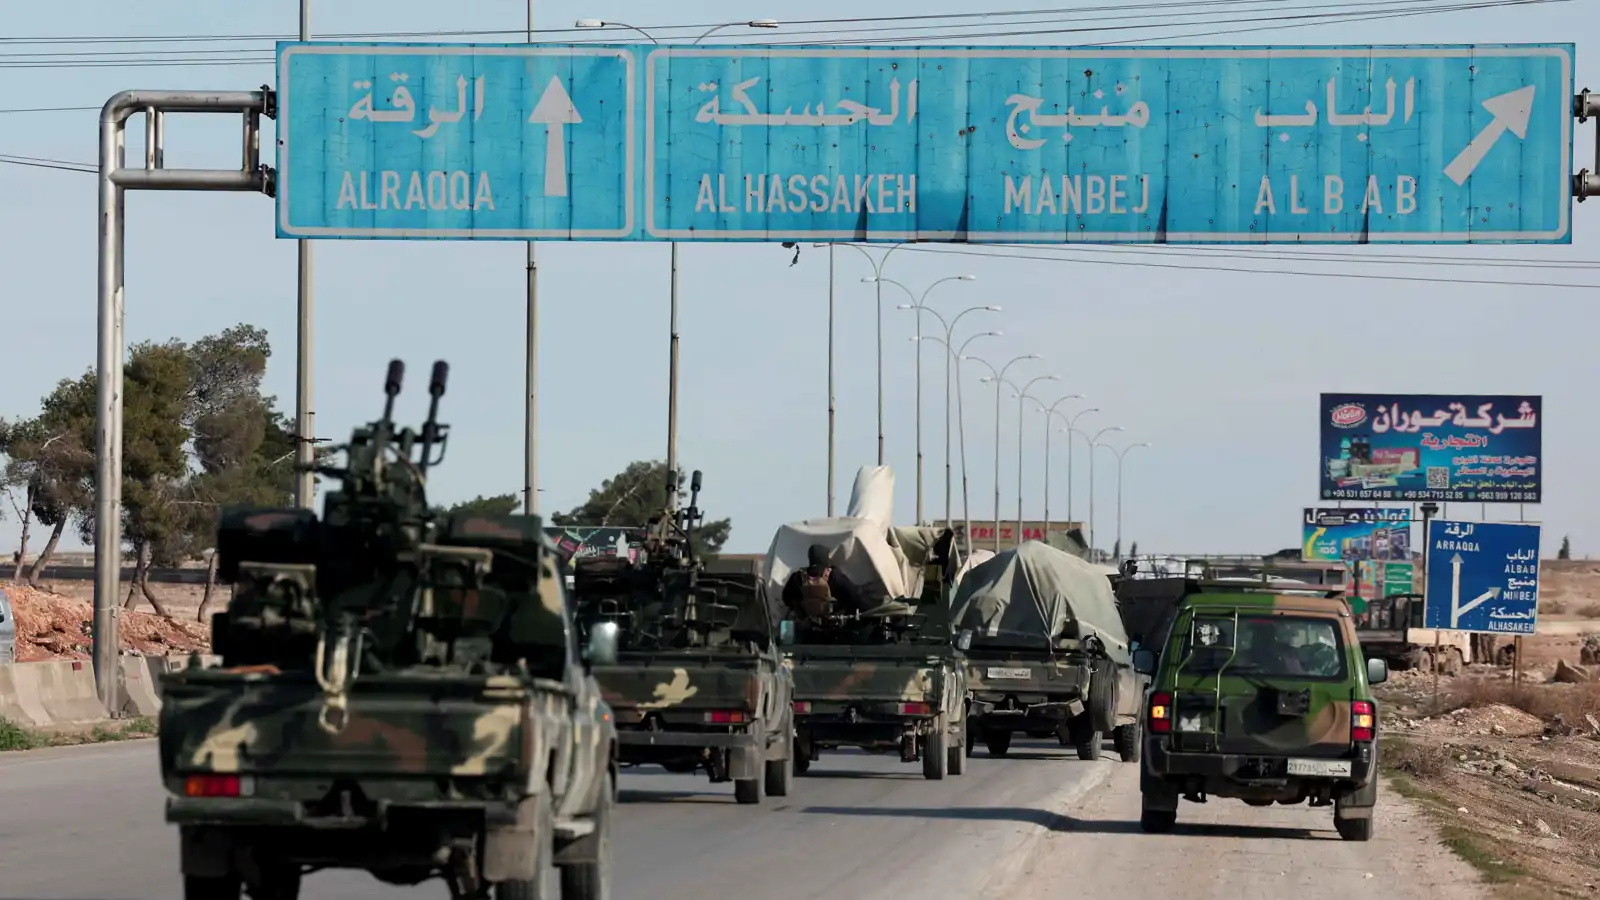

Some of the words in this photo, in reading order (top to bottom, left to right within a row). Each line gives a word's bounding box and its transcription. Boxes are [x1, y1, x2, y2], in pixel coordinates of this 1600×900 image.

[348, 72, 485, 138] الرقة
[694, 76, 919, 127] الحسكة
[1005, 83, 1150, 150] منبج
[1255, 76, 1415, 142] الباب
[336, 170, 495, 210] ALRAQQA
[695, 173, 736, 213] AL
[745, 174, 917, 214] HASSAKEH
[1004, 175, 1150, 214] MANBEJ
[1372, 402, 1452, 433] حوران
[1449, 400, 1536, 435] شركة
[1421, 432, 1488, 450] التجارية
[1436, 540, 1480, 552] ARRAQQA
[1444, 523, 1474, 538] الرقة
[1504, 564, 1536, 574] ALBAB
[1506, 548, 1535, 563] الباب
[1507, 576, 1536, 589] منبج
[1488, 621, 1534, 632] ALHASAKEH
[1489, 607, 1536, 619] الحسكة
